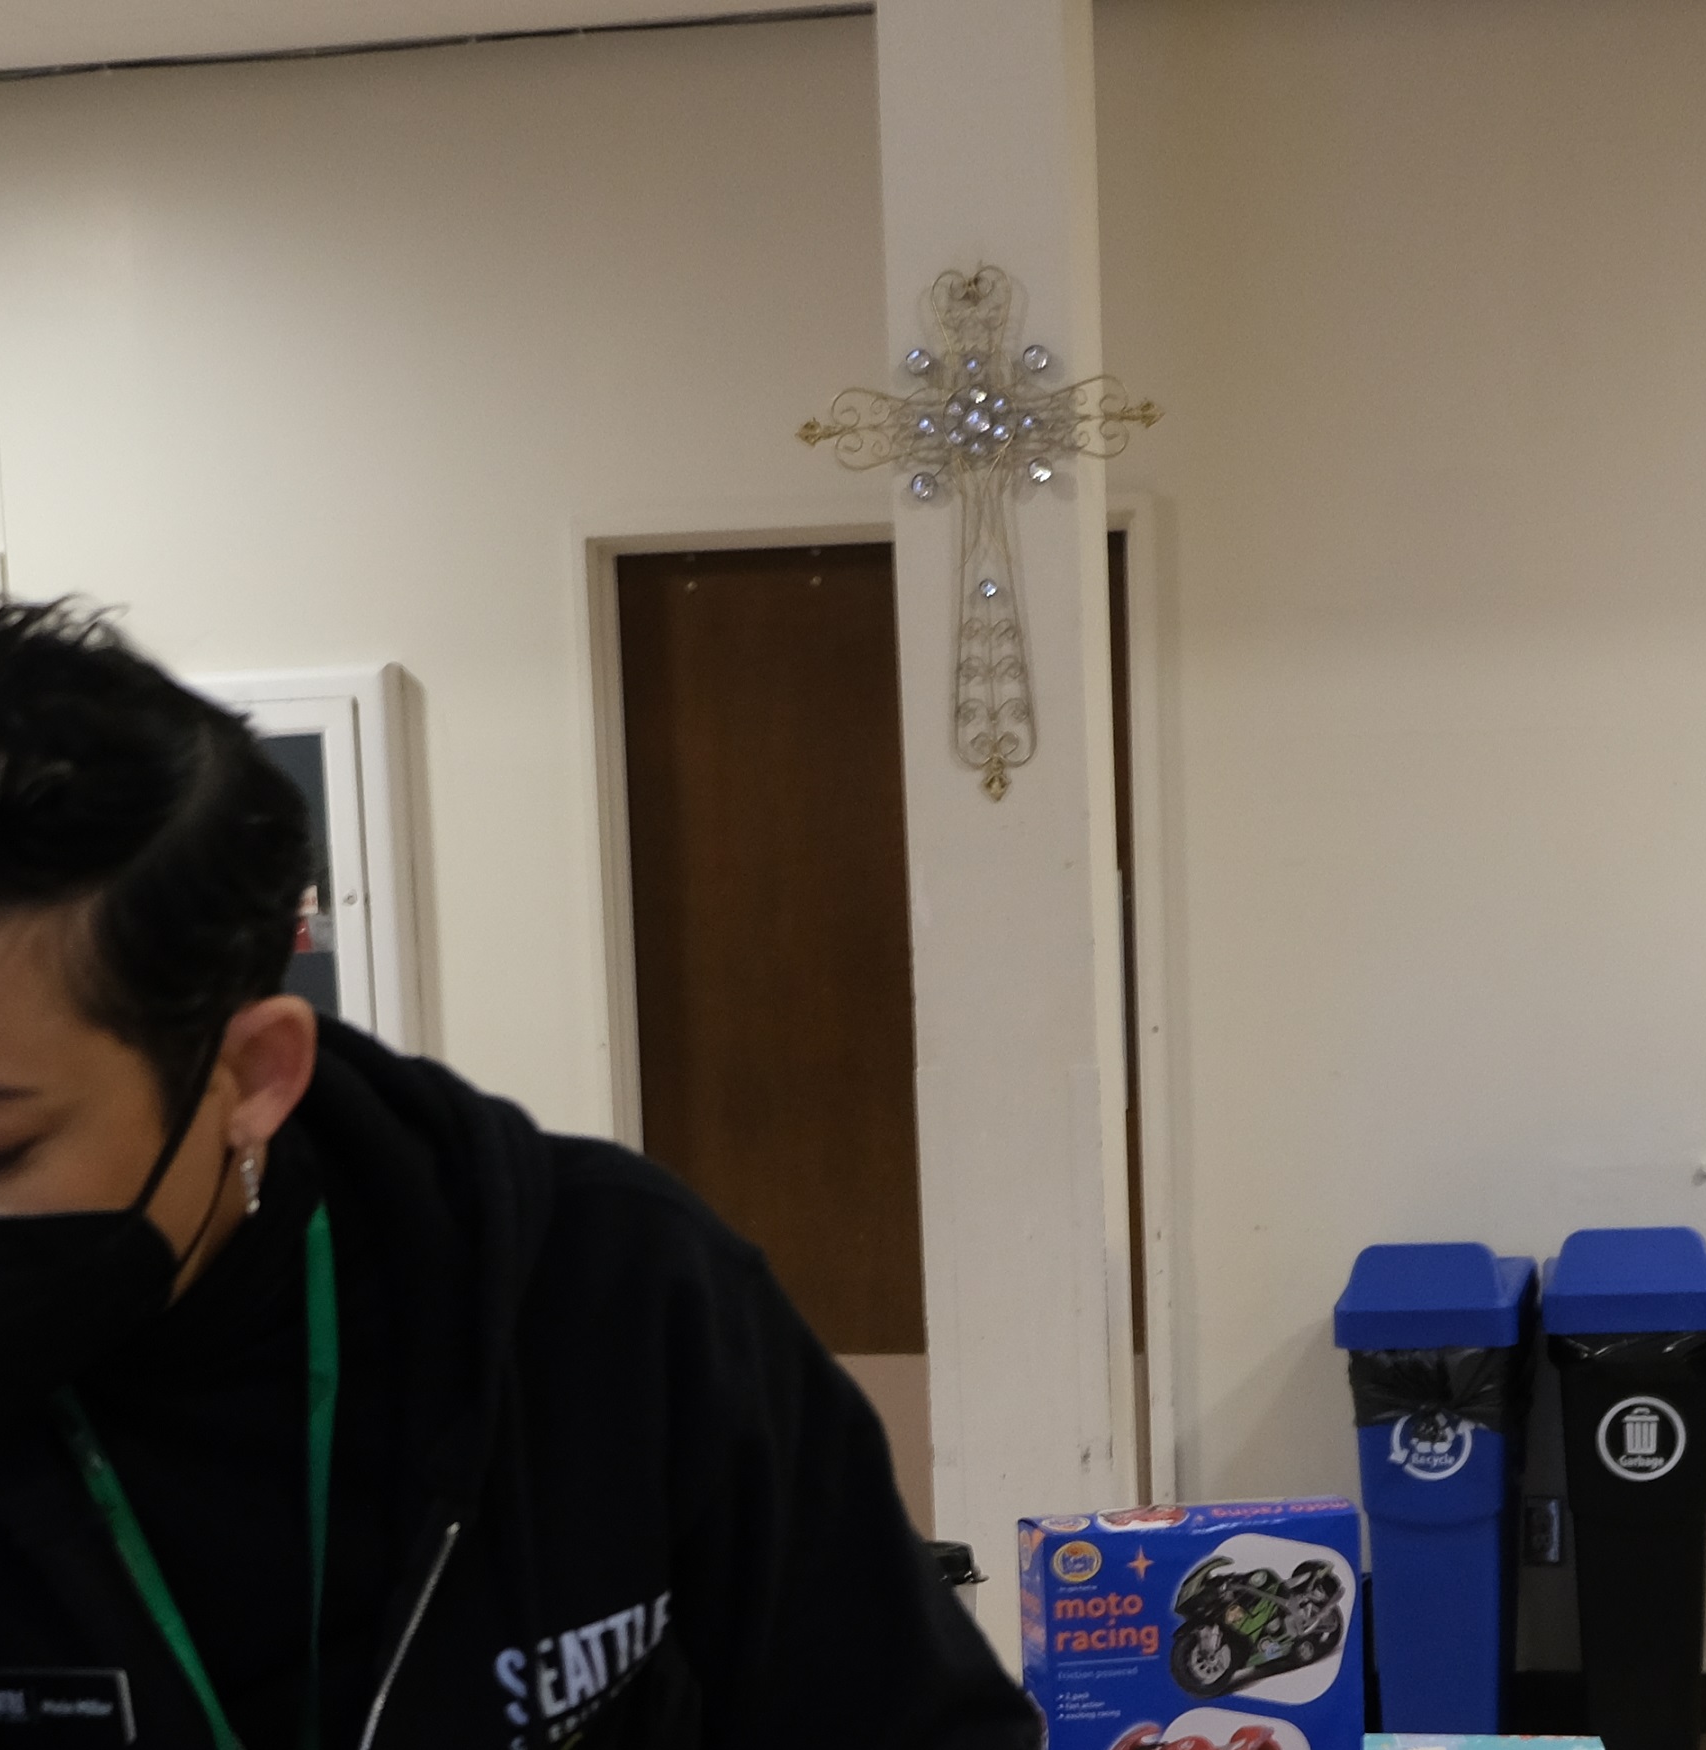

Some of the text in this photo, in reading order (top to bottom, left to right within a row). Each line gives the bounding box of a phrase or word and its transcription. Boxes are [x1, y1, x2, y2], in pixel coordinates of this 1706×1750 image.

[1411, 1453, 1455, 1468] Recycle
[1619, 1455, 1665, 1470] Garbage
[1054, 1593, 1143, 1619] moto
[1055, 1618, 1159, 1655] racing
